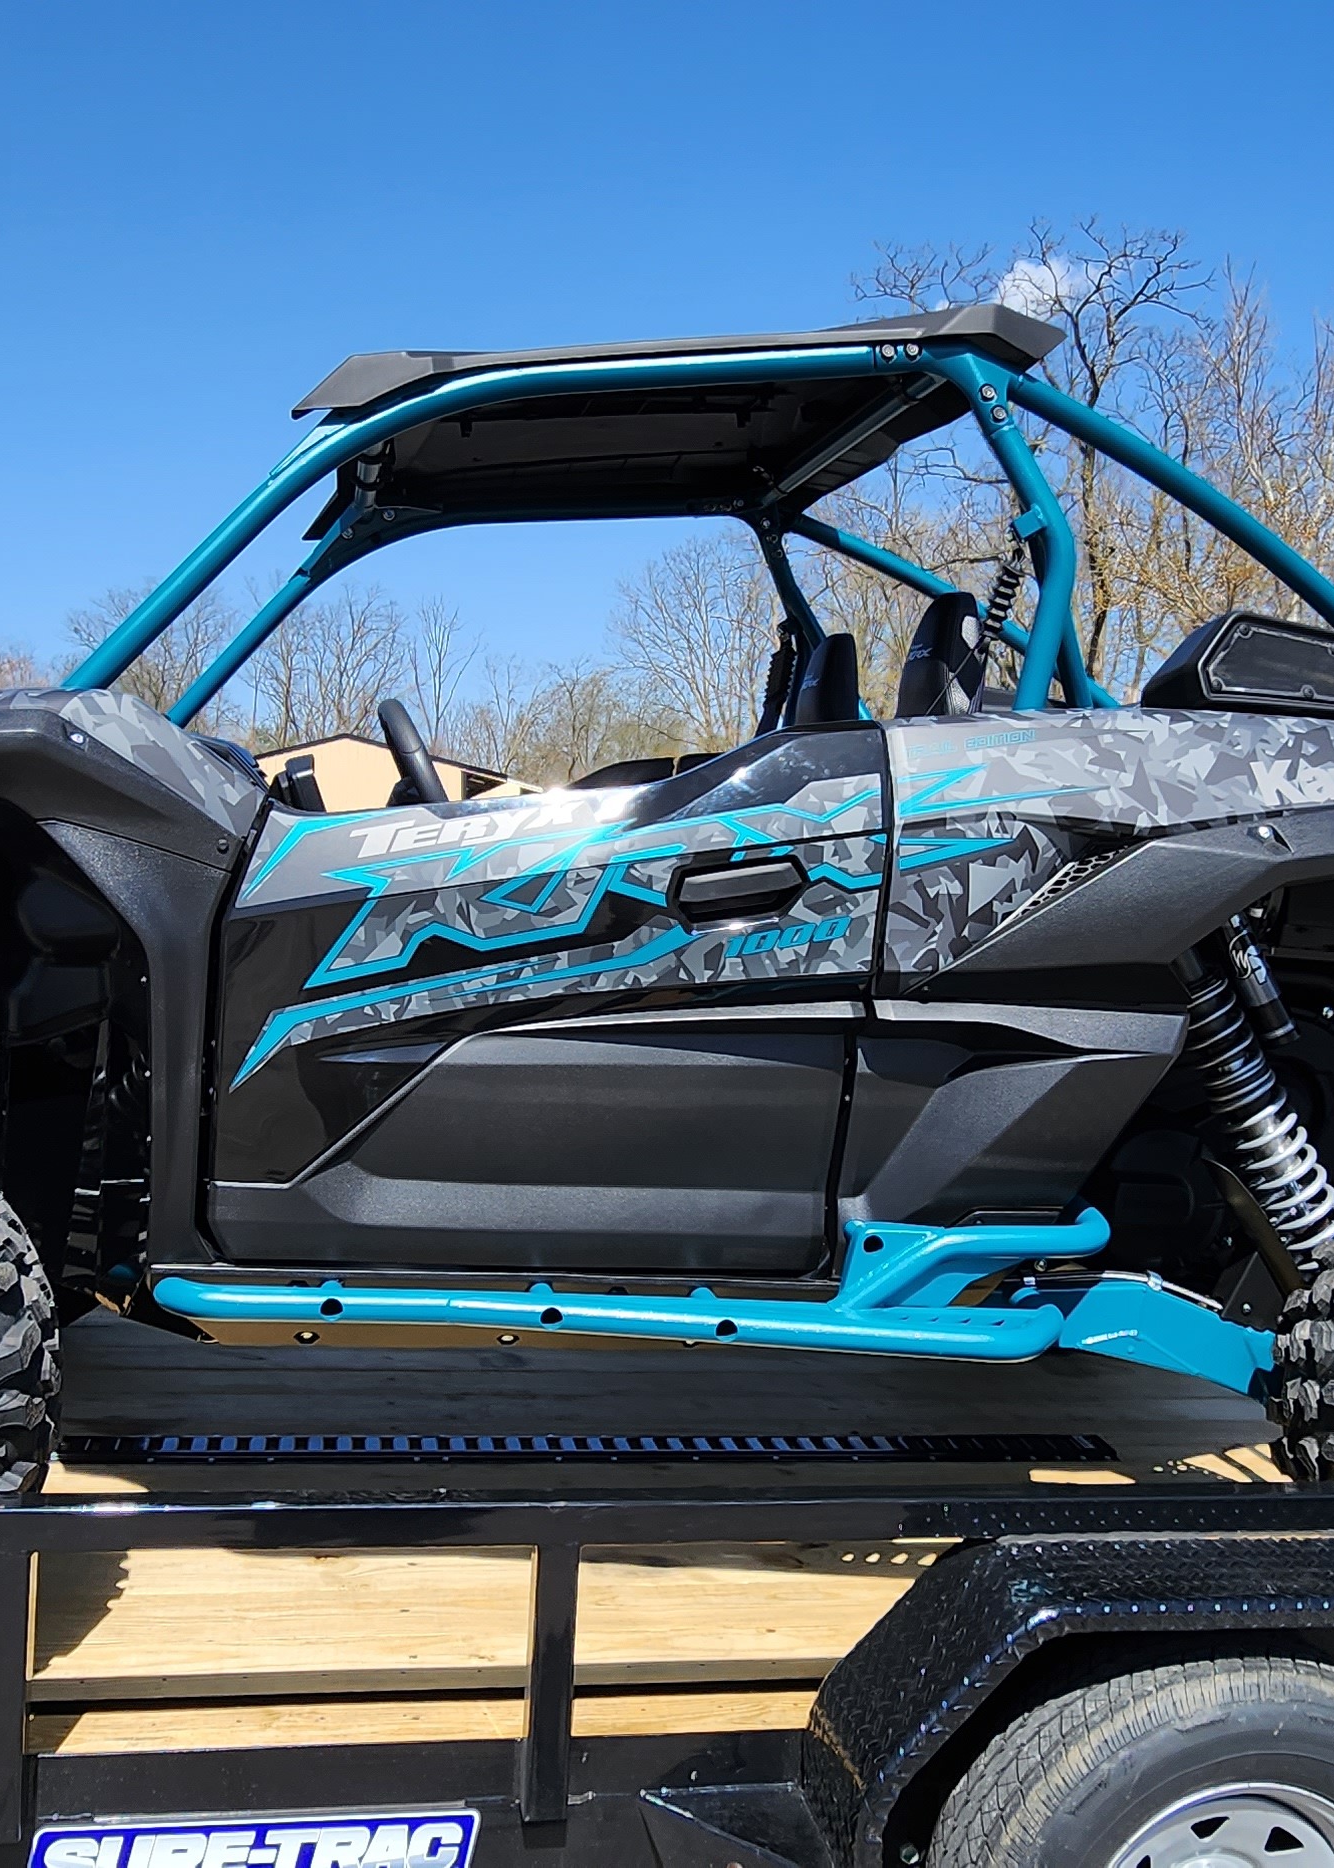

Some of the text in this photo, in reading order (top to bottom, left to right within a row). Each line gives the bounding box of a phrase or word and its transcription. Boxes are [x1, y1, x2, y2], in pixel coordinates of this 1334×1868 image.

[964, 729, 1035, 751] EDITION
[350, 800, 585, 859] TERYX
[724, 915, 853, 958] 1000
[43, 1822, 464, 1868] SURE-TRAC
